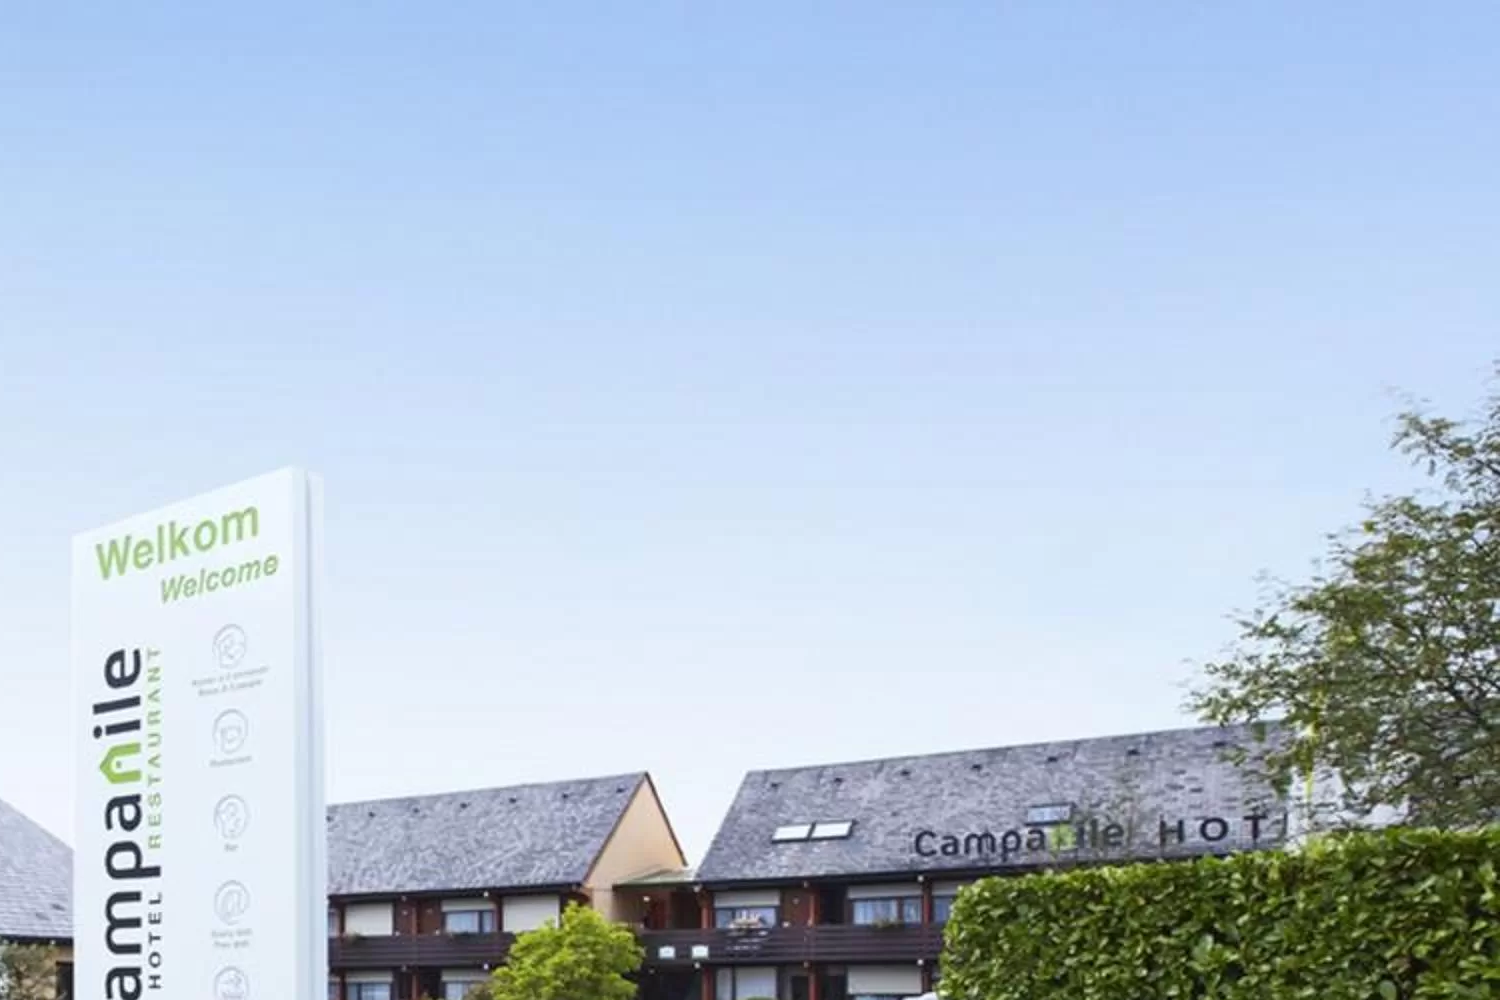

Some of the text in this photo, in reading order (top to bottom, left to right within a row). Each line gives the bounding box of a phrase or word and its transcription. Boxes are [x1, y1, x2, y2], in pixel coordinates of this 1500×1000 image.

[95, 505, 259, 580] Welkom
[160, 554, 279, 604] Welcome
[147, 647, 162, 990] HOTEL RESTAURANT
